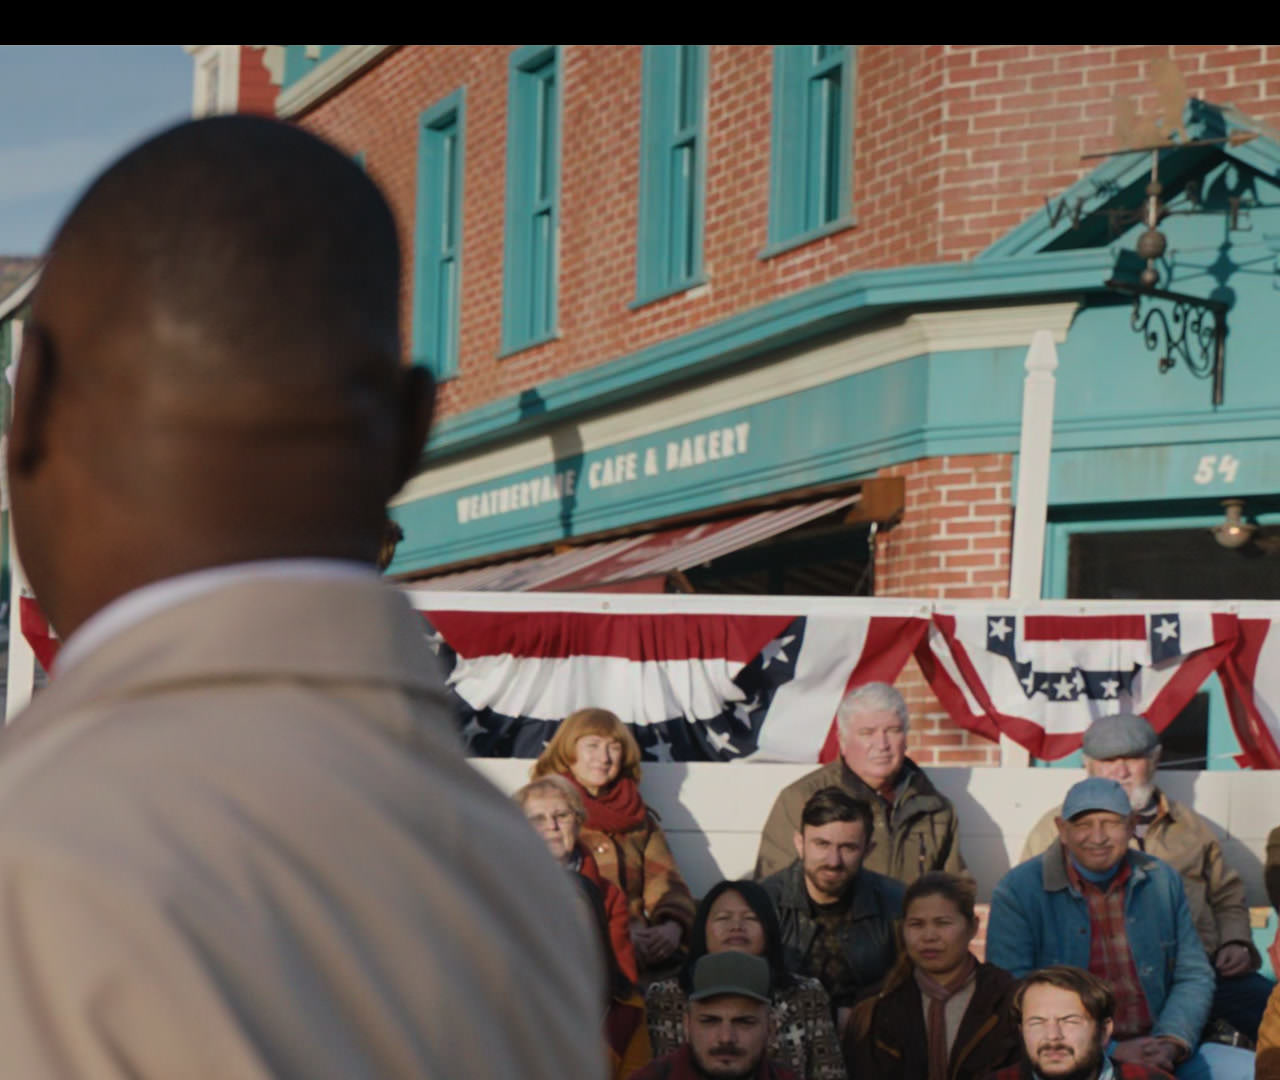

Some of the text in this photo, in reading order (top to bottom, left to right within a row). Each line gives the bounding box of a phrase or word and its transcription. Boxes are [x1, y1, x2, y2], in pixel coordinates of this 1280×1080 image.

[456, 468, 576, 525] WEATHERVANE
[589, 452, 639, 490] CAFE
[666, 422, 751, 472] BAKERY
[1194, 454, 1238, 485] 54
